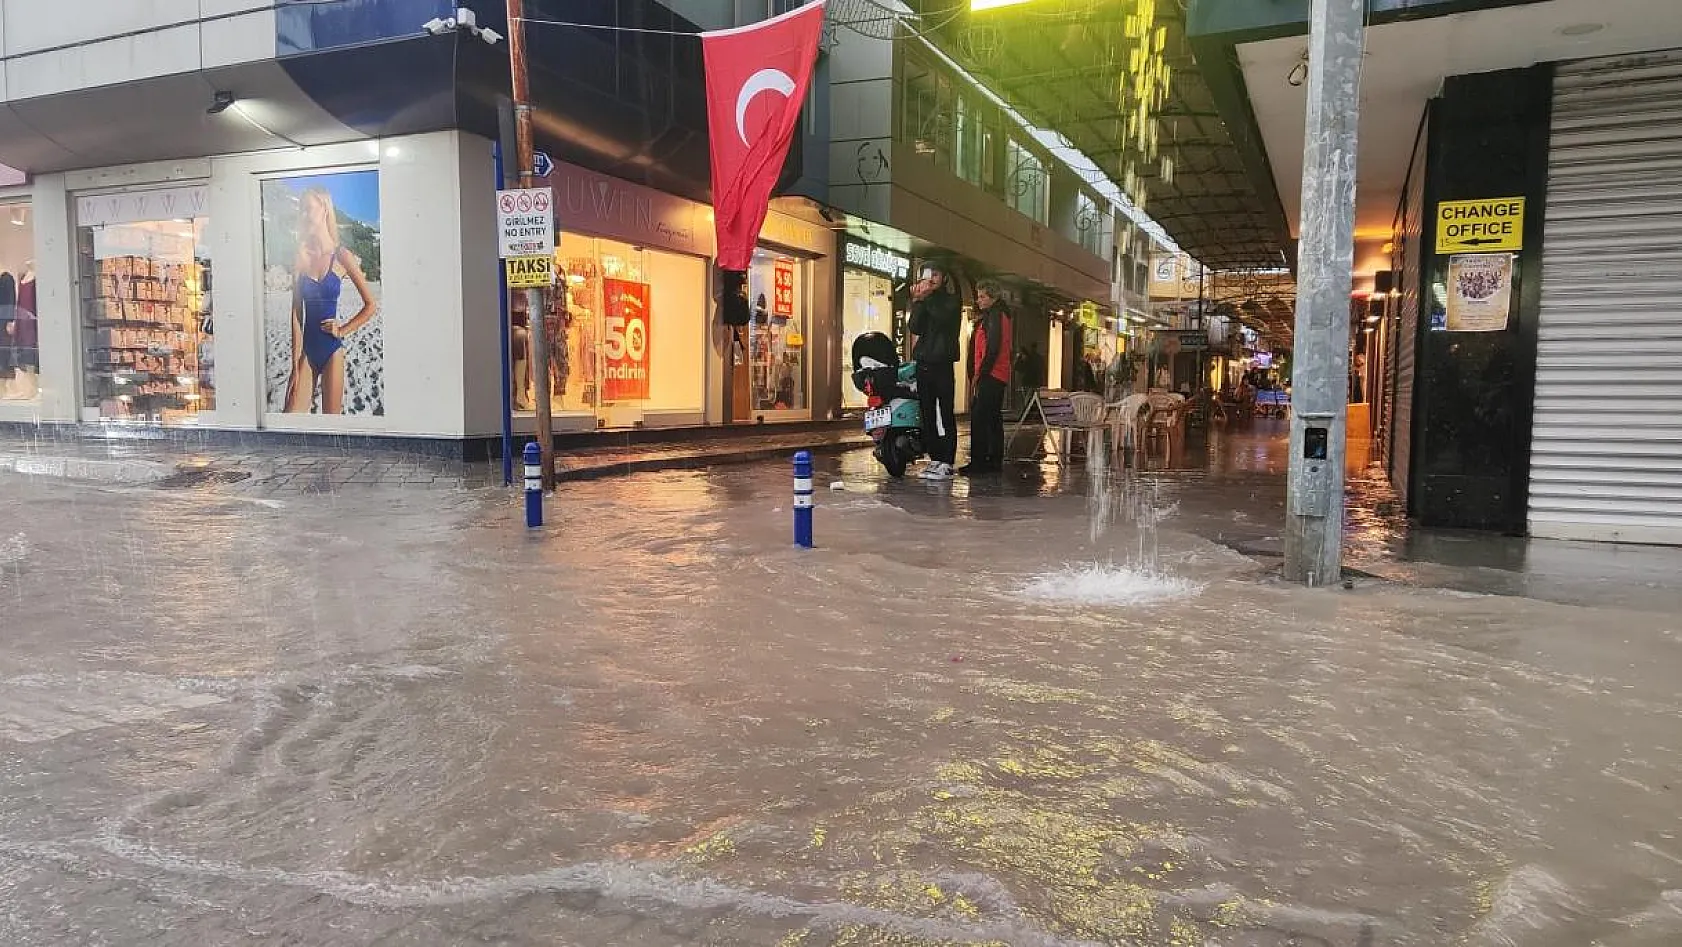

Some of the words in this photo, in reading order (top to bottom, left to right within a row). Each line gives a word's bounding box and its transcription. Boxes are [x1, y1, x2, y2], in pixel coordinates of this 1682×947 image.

[1442, 203, 1520, 220] CHANGE
[505, 228, 518, 237] NO
[520, 227, 546, 237] ENTRY
[1446, 222, 1513, 237] OFFICE
[605, 316, 646, 361] 50
